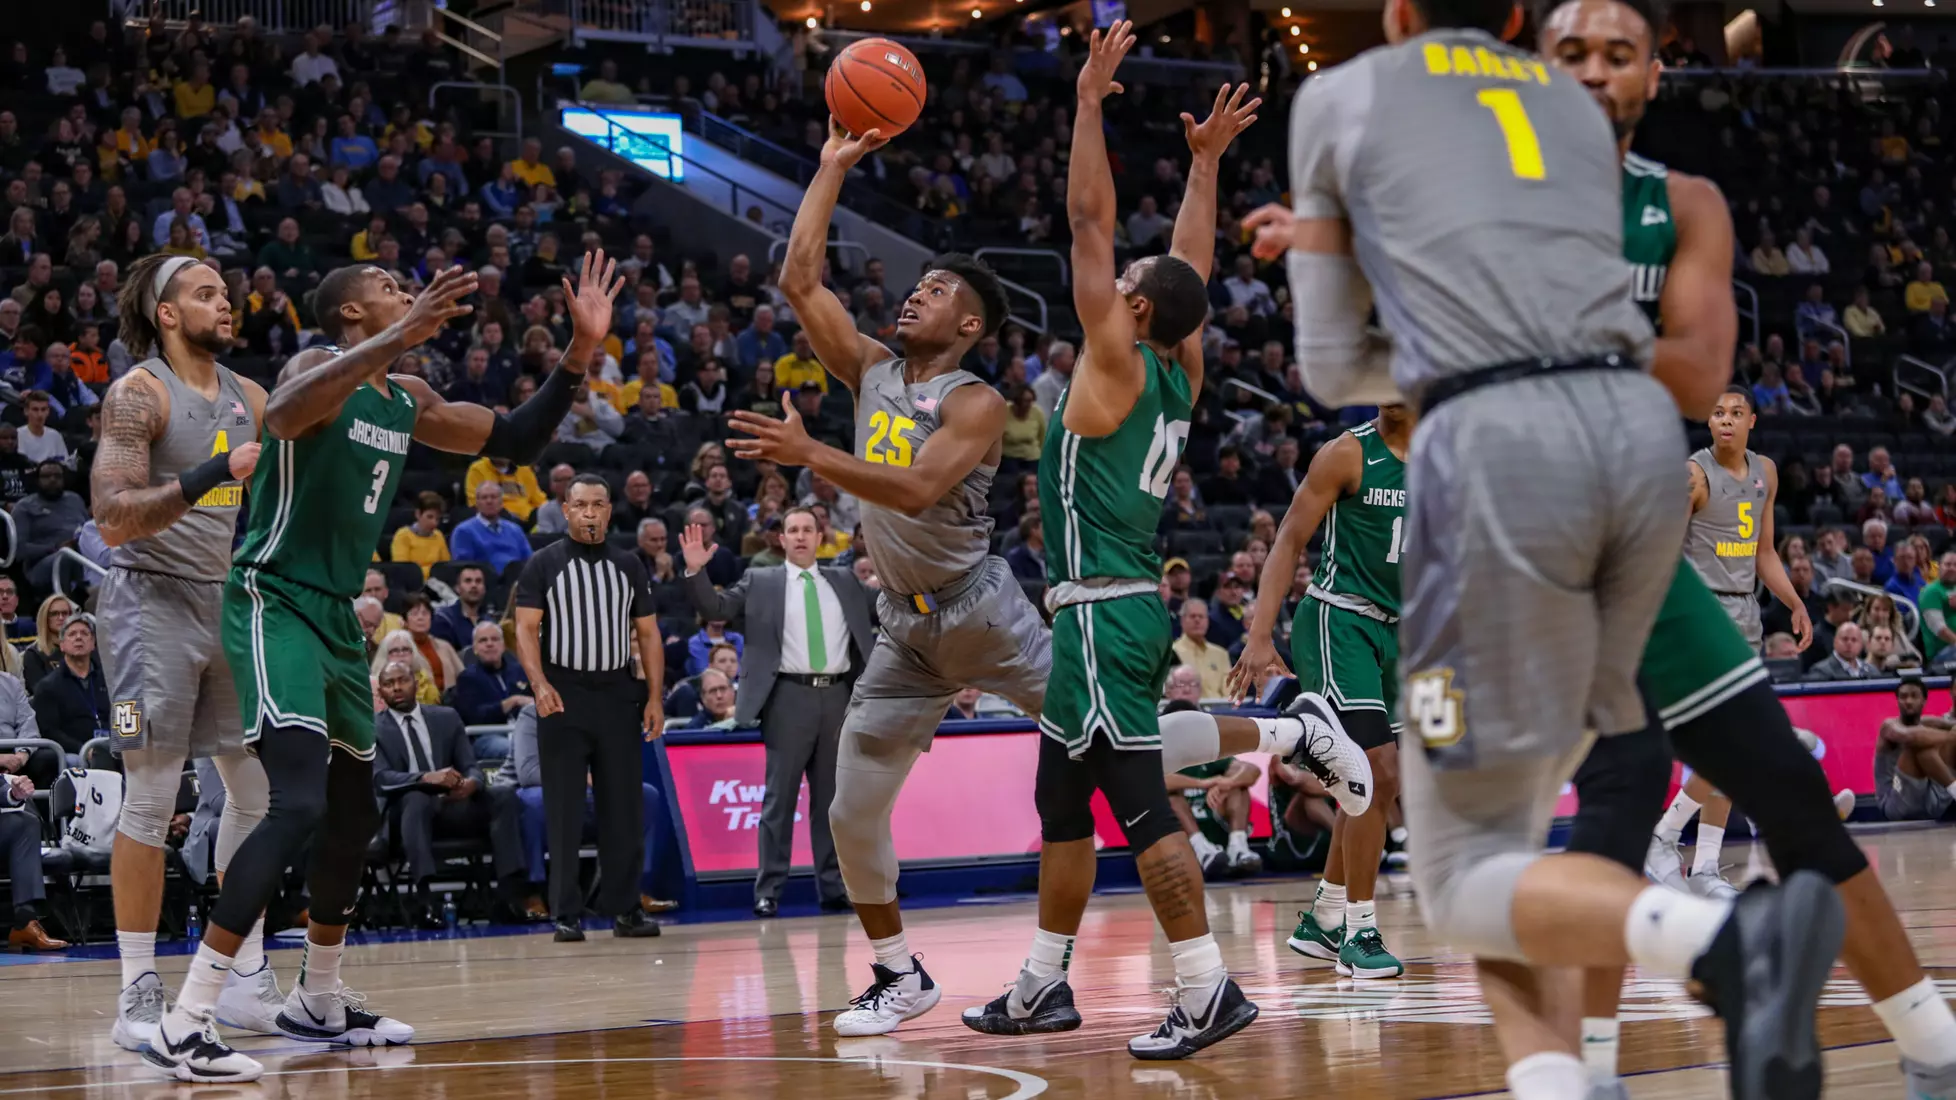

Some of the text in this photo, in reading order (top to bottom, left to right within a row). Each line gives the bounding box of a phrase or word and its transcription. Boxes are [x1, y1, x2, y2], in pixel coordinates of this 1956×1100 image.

[1423, 43, 1551, 86] BAILEY
[1477, 88, 1546, 181] 1
[865, 410, 916, 468] 25
[1139, 412, 1191, 499] 10
[363, 459, 390, 514] 3
[1363, 488, 1406, 507] JACKS
[1738, 501, 1754, 538] 5
[113, 701, 141, 737] MU
[1408, 668, 1466, 748] MU
